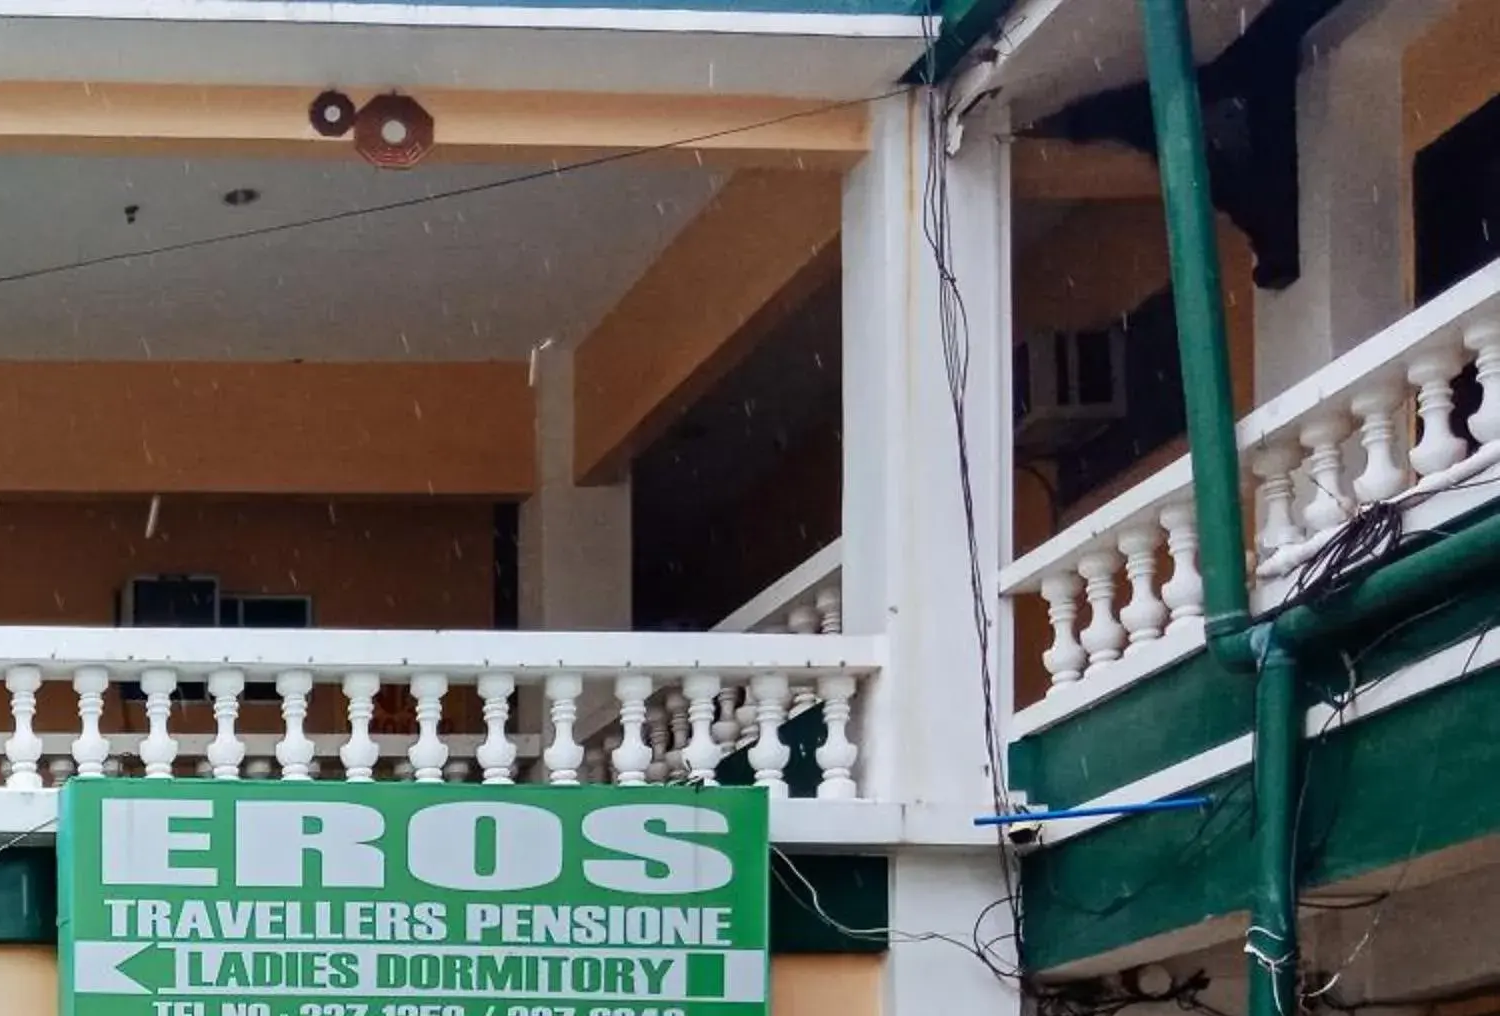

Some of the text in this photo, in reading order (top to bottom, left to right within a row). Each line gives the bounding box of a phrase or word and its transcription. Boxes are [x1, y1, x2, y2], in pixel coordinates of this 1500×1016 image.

[101, 797, 733, 894] EROS
[103, 899, 733, 946] TRAVELLERS PENSIONE
[187, 950, 675, 995] LADIES DORMITORY
